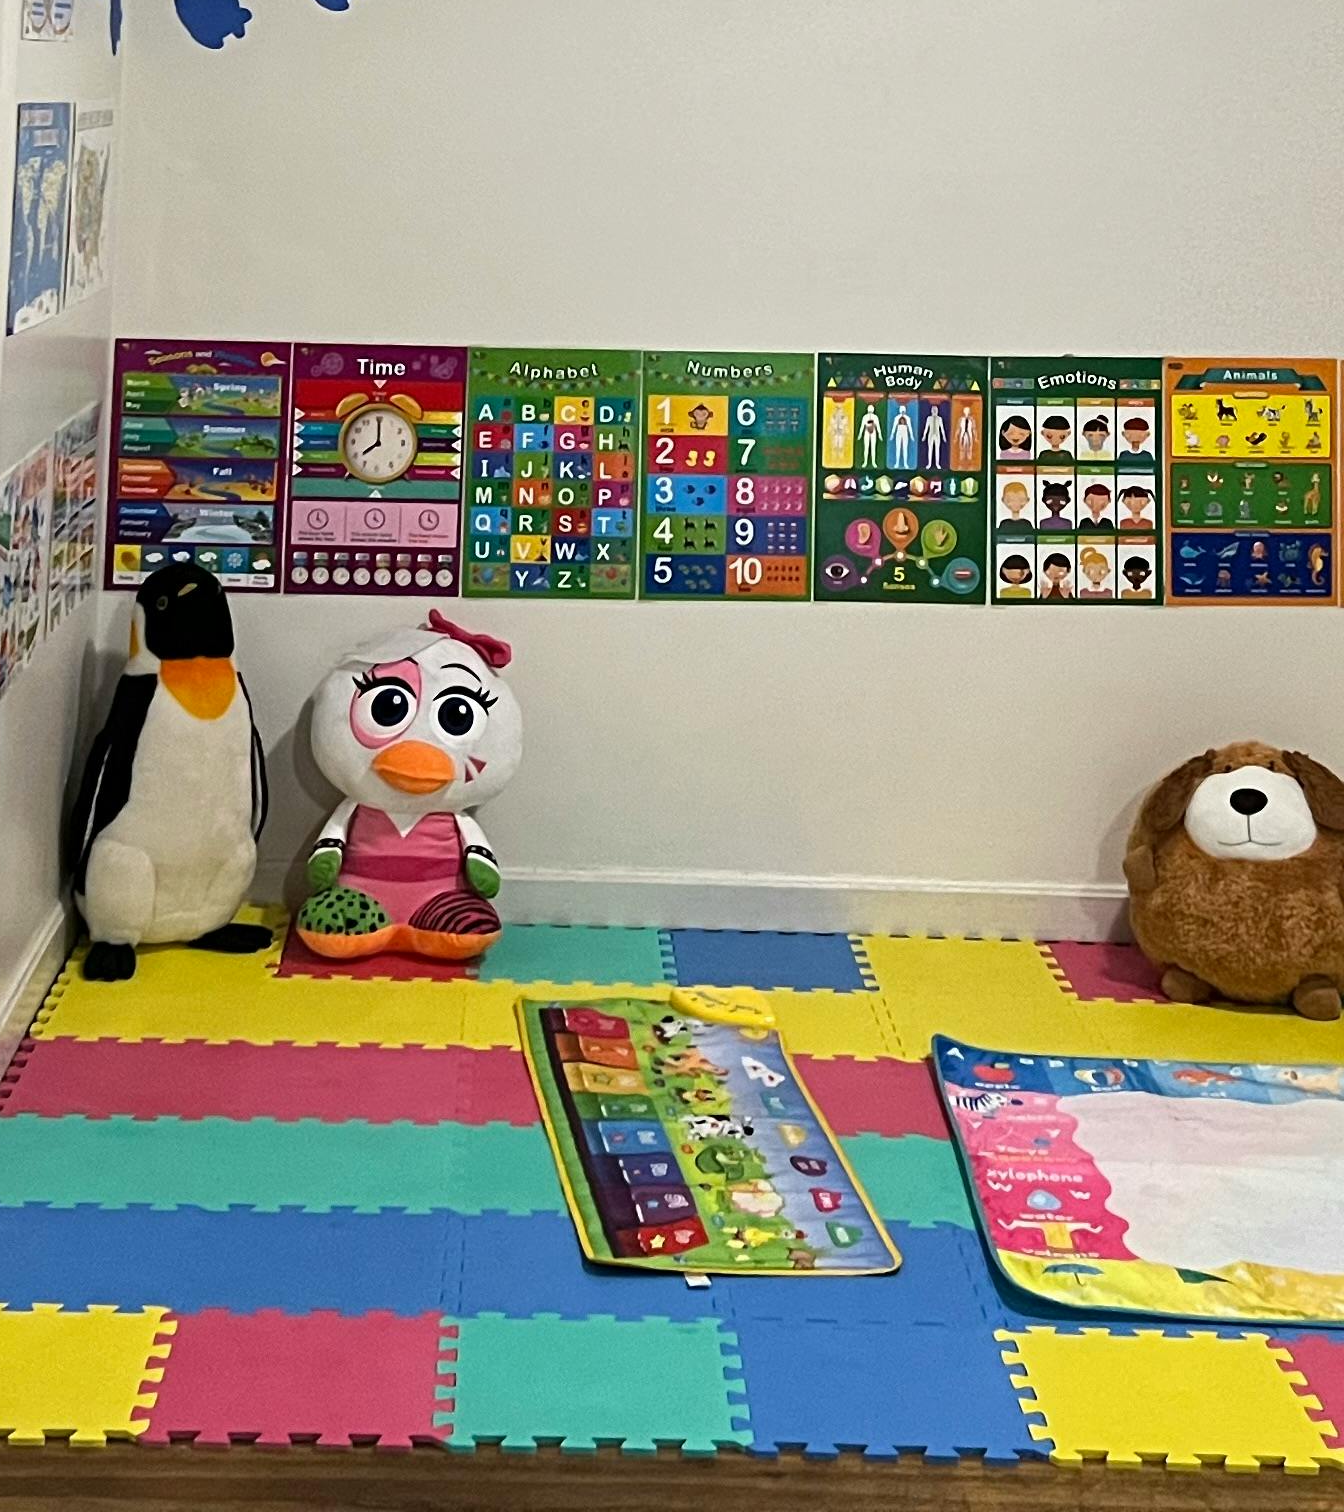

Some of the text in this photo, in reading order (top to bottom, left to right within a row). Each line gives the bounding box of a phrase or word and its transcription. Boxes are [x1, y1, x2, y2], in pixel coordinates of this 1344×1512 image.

[357, 358, 406, 376] Time
[510, 361, 599, 380] Alphabet
[686, 360, 773, 379] Numbers
[873, 364, 934, 379] Human
[1223, 370, 1278, 381] Animals
[885, 375, 922, 390] Body
[1037, 371, 1117, 390] Emotions
[478, 404, 494, 421] A
[521, 405, 535, 421] B
[561, 405, 576, 422] C
[600, 406, 614, 422] D
[656, 398, 671, 425] 1
[736, 399, 756, 426] 6
[479, 431, 493, 448] E
[523, 432, 534, 449] F
[560, 432, 575, 449] G
[599, 434, 613, 450] H
[655, 438, 674, 465] 2
[737, 439, 756, 466] 7
[481, 459, 488, 477] I
[521, 461, 532, 477] J
[560, 462, 574, 479] K
[600, 462, 611, 479] L
[476, 487, 492, 504] M
[519, 488, 533, 504] N
[558, 488, 574, 505] O
[599, 489, 611, 506] P
[655, 477, 674, 504] 3
[736, 477, 755, 505] 8
[475, 514, 491, 532] Q
[519, 515, 533, 532] R
[559, 515, 572, 532] S
[597, 517, 611, 534] T
[653, 517, 674, 545] 4
[734, 518, 754, 546] 9
[475, 541, 490, 558] U
[516, 543, 531, 559] V
[555, 542, 575, 560] W
[597, 543, 610, 560] X
[516, 571, 529, 587] Y
[654, 557, 672, 584] 5
[729, 558, 763, 585] 10
[893, 567, 906, 582] 5
[558, 571, 572, 588] Z
[986, 1168, 1083, 1184] xylophone
